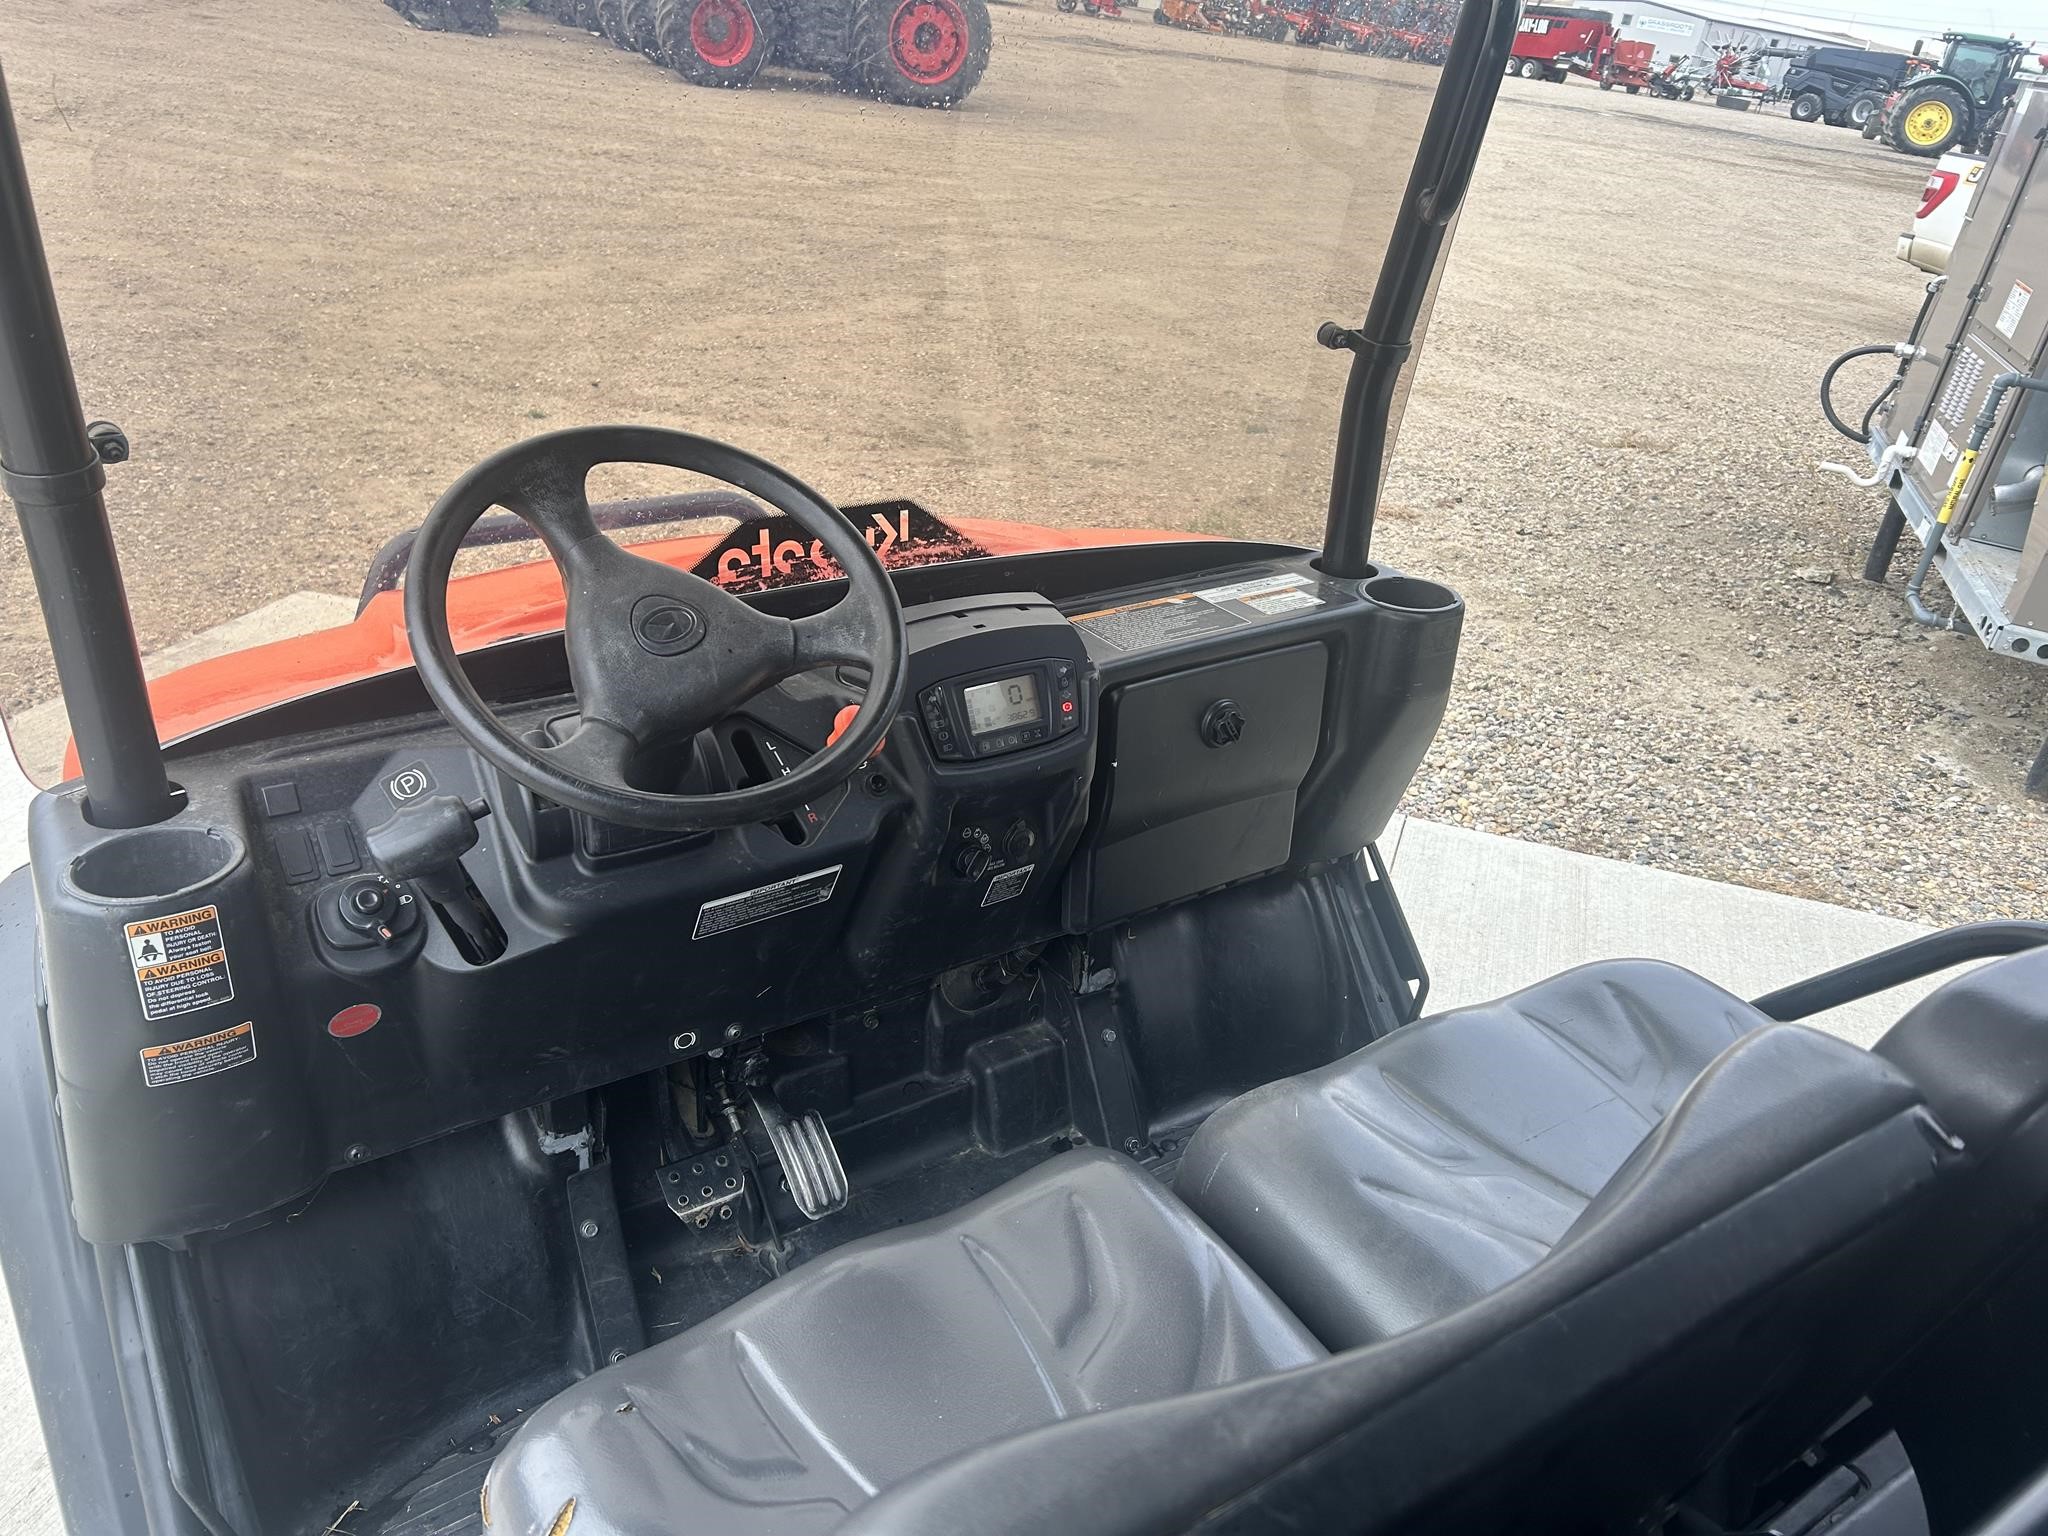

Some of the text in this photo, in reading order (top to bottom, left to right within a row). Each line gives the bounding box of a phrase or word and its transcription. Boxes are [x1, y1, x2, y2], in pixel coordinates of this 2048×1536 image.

[1008, 684, 1023, 705] 0
[766, 742, 776, 751] L
[750, 878, 798, 896] IMPORTANT
[146, 910, 211, 933] WARNING
[165, 930, 201, 942] PERSONAL
[166, 940, 185, 948] INJURY
[167, 940, 211, 954] Always fasten
[156, 954, 220, 976] WARNING
[144, 983, 168, 992] INJURY
[196, 972, 214, 980] LOSS
[154, 976, 175, 984] AVOID
[176, 966, 212, 978] PERSONAL
[155, 984, 190, 996] STEERING
[170, 989, 195, 999] depress
[160, 995, 193, 1006] differential
[172, 1031, 236, 1051] WARNING
[157, 1053, 177, 1061] AVOID
[179, 1045, 214, 1056] PERSONAL
[170, 1054, 192, 1062] operate
